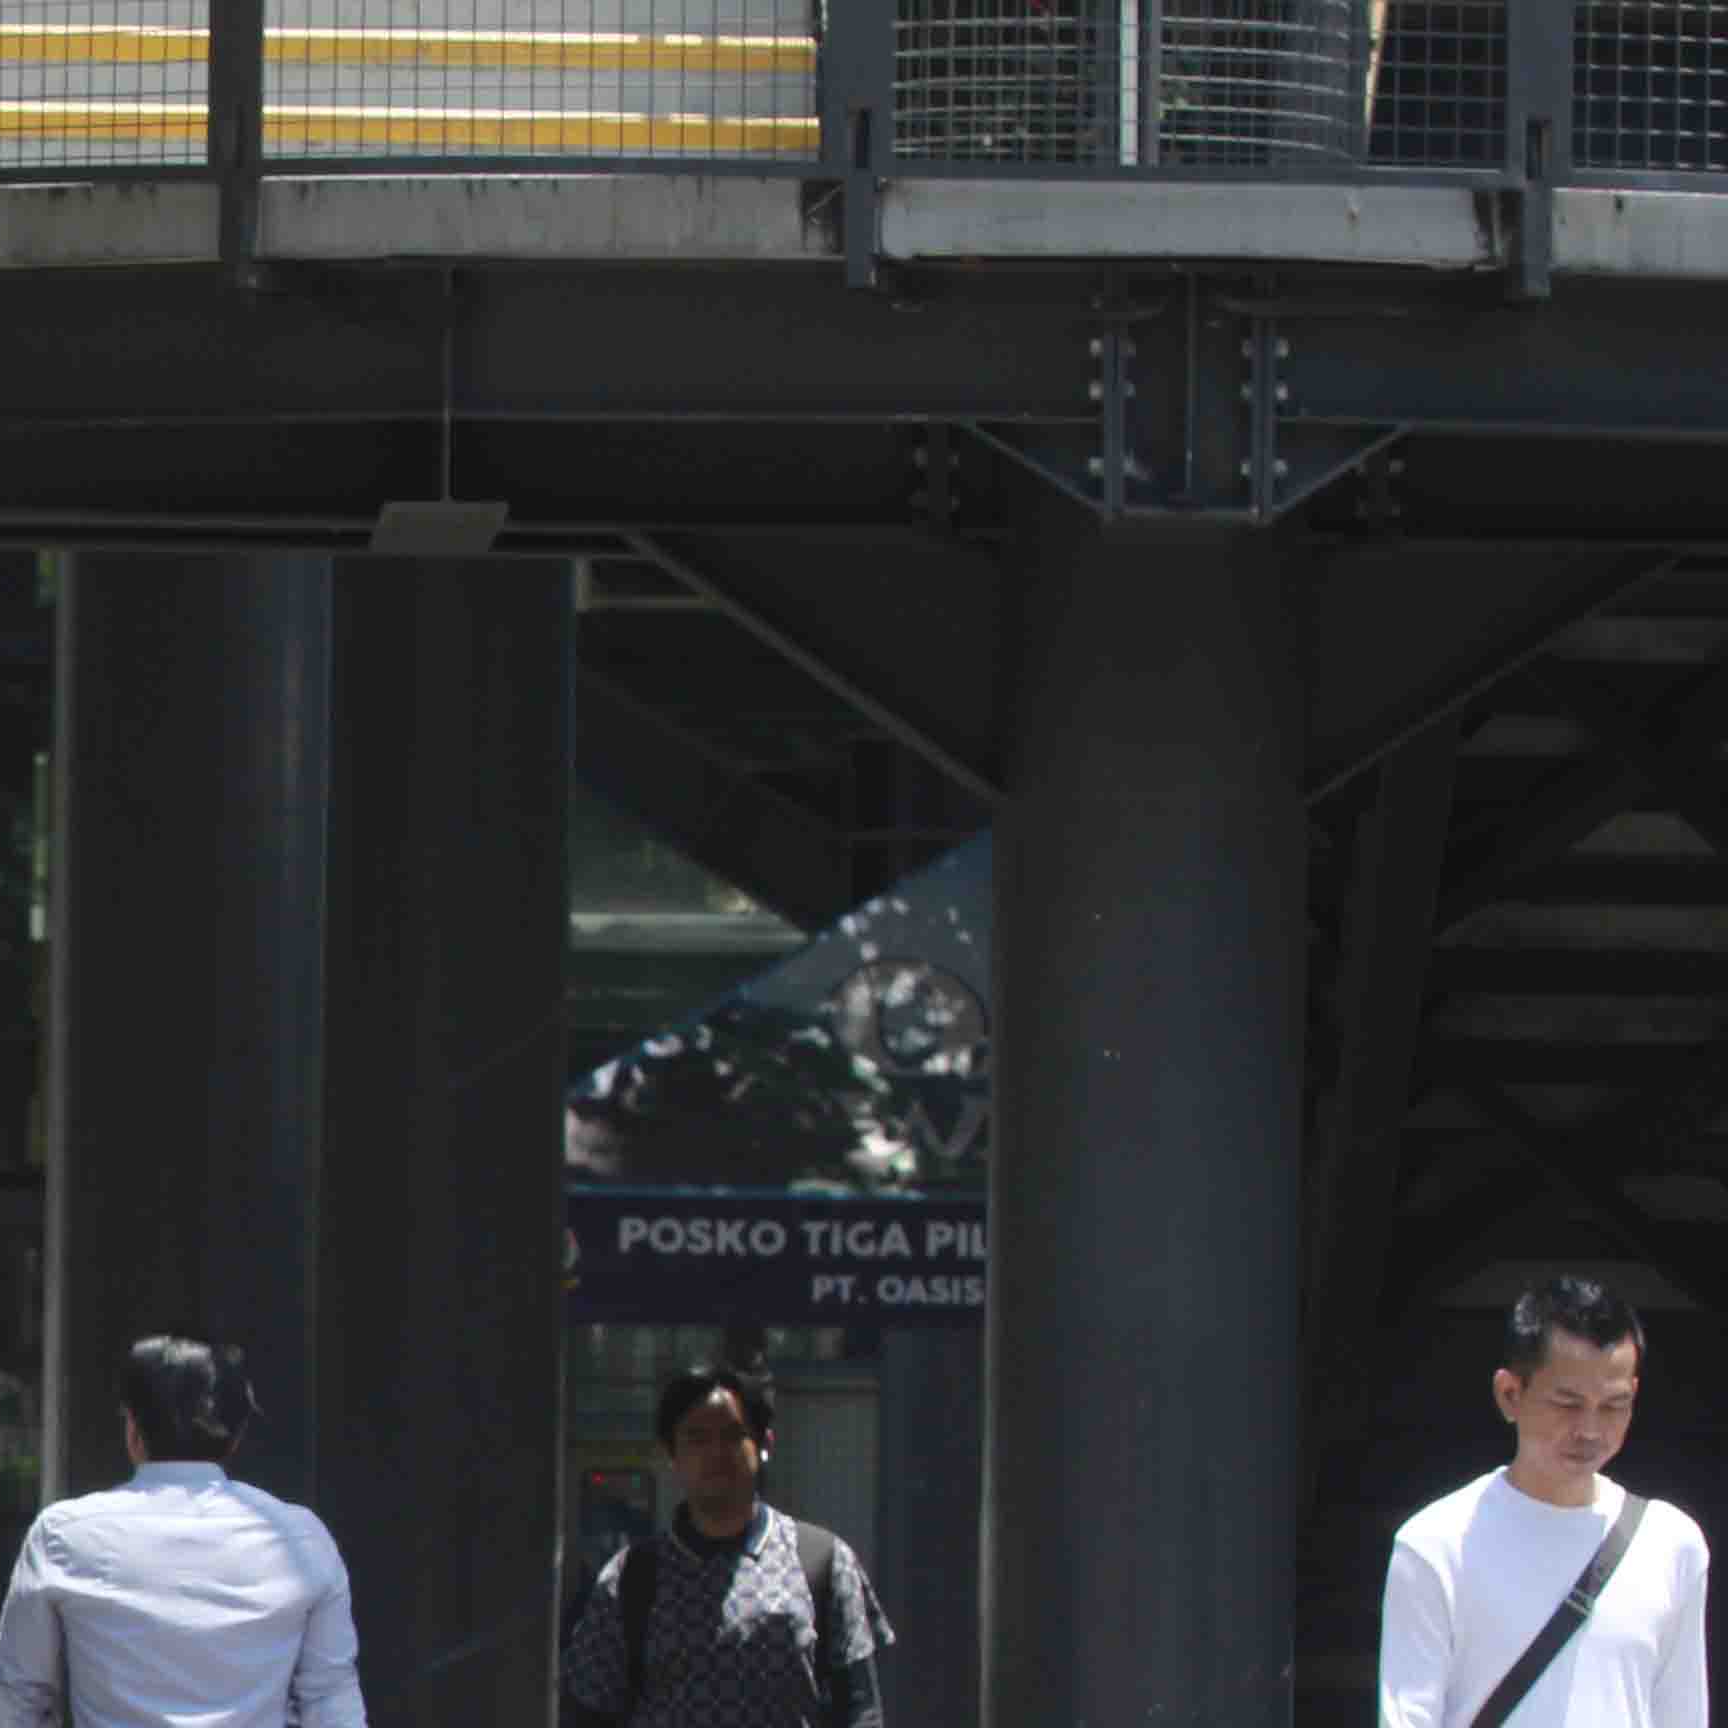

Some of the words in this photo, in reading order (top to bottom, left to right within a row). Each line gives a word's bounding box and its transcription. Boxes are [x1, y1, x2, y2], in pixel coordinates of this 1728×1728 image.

[618, 1216, 788, 1256] POSKO
[801, 1219, 912, 1258] TIGA
[812, 1274, 867, 1304] PT.
[876, 1275, 985, 1305] OASIS
